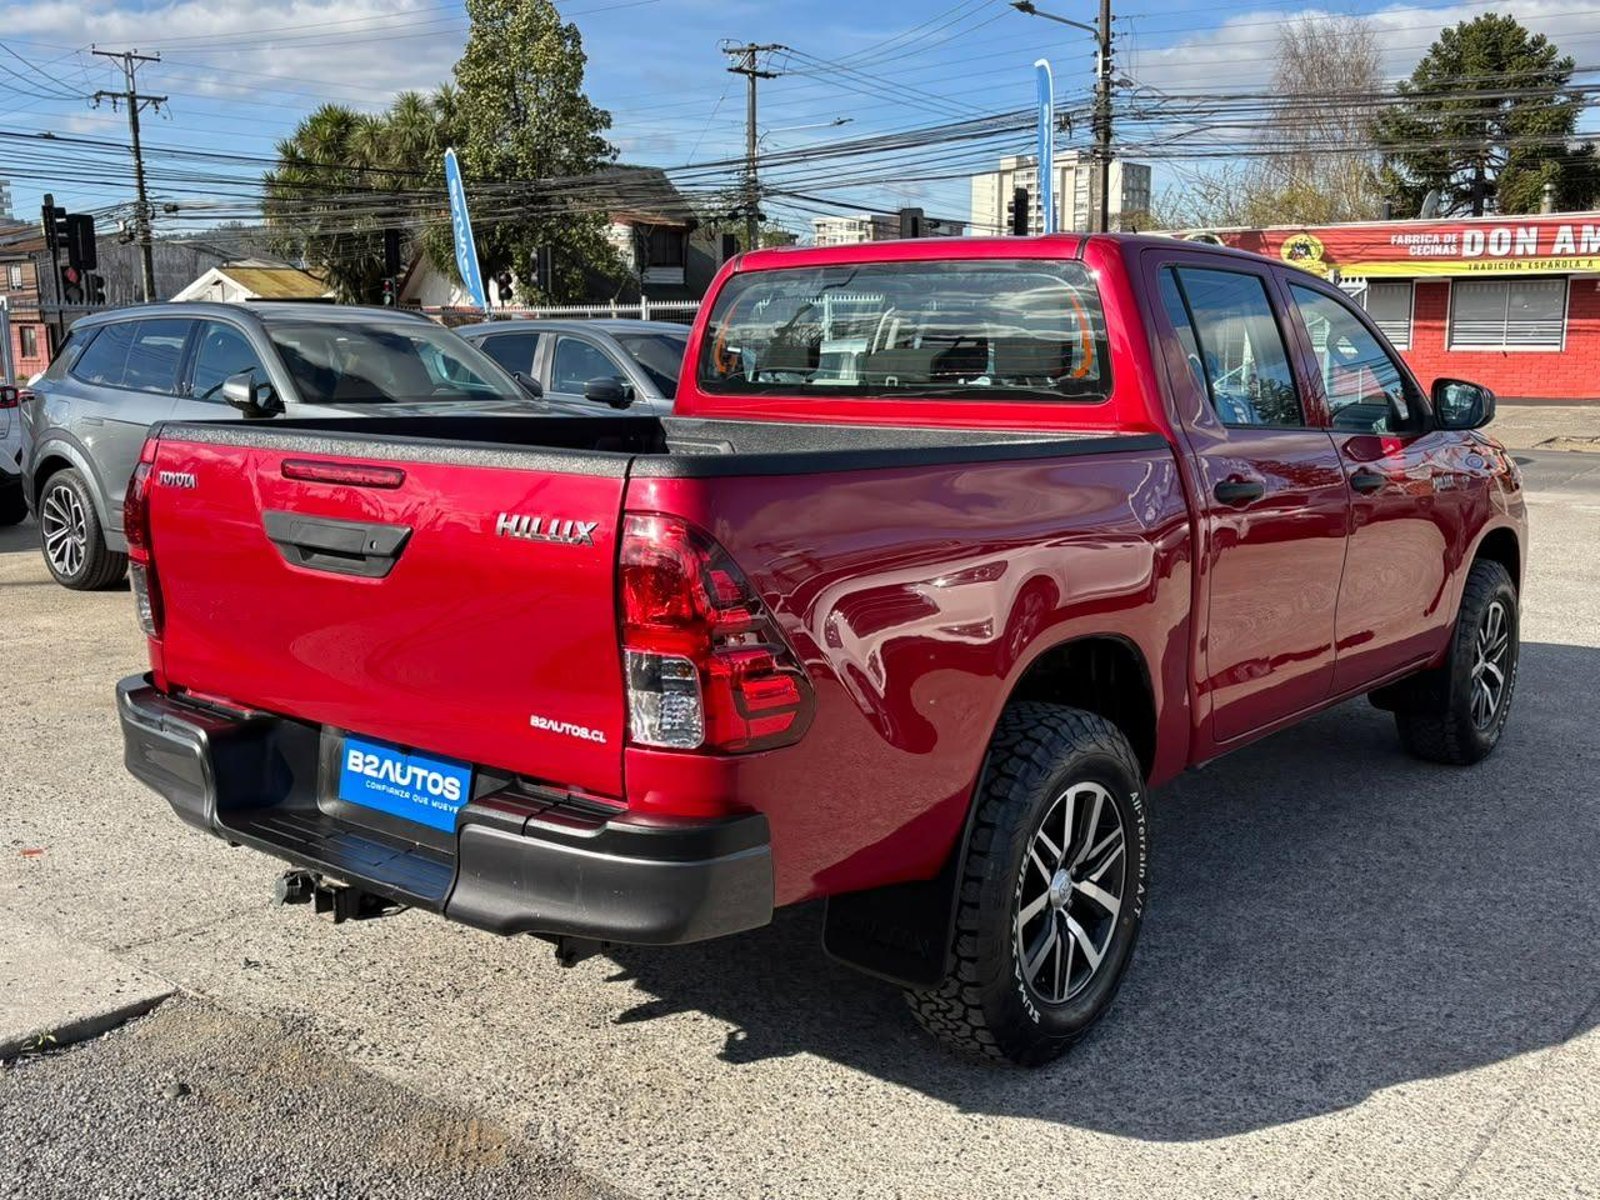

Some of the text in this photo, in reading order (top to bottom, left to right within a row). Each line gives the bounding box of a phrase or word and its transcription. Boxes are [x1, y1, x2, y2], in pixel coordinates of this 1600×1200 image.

[1391, 233, 1458, 245] FABRICA DE
[1409, 244, 1458, 256] CECINAS
[1462, 226, 1538, 257] DON
[1468, 261, 1522, 271] TRADICIÓN
[1528, 259, 1581, 270] ESPAÑOLA
[159, 470, 196, 489] TOYOTA
[496, 512, 599, 546] HILUX
[529, 714, 608, 744] B2AUTOS.CL
[347, 749, 461, 801] B2AUTOS
[365, 780, 411, 799] CONFIANZA
[412, 793, 429, 806] QUE
